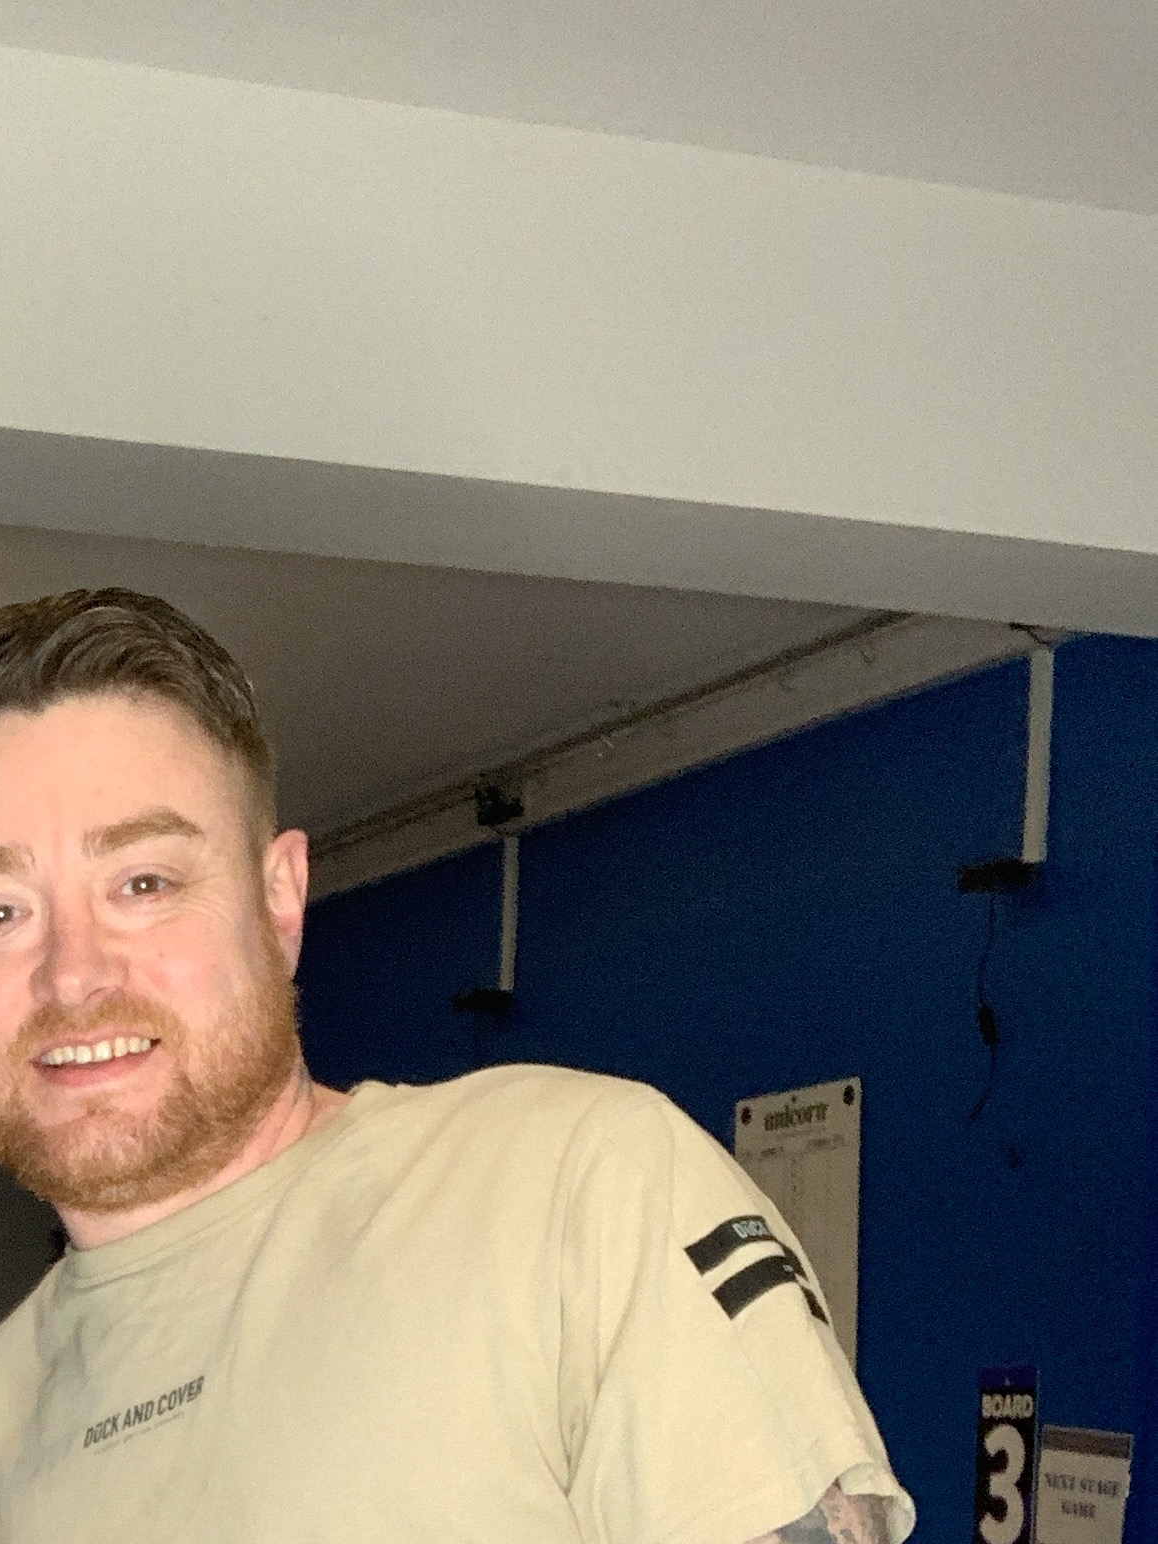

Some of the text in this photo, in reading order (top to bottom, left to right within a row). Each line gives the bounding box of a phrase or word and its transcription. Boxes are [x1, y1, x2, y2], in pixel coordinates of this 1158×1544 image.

[84, 1412, 121, 1448] DUCK
[122, 1400, 155, 1431] AND
[156, 1375, 205, 1416] COVER
[981, 1392, 1035, 1420] BOARD
